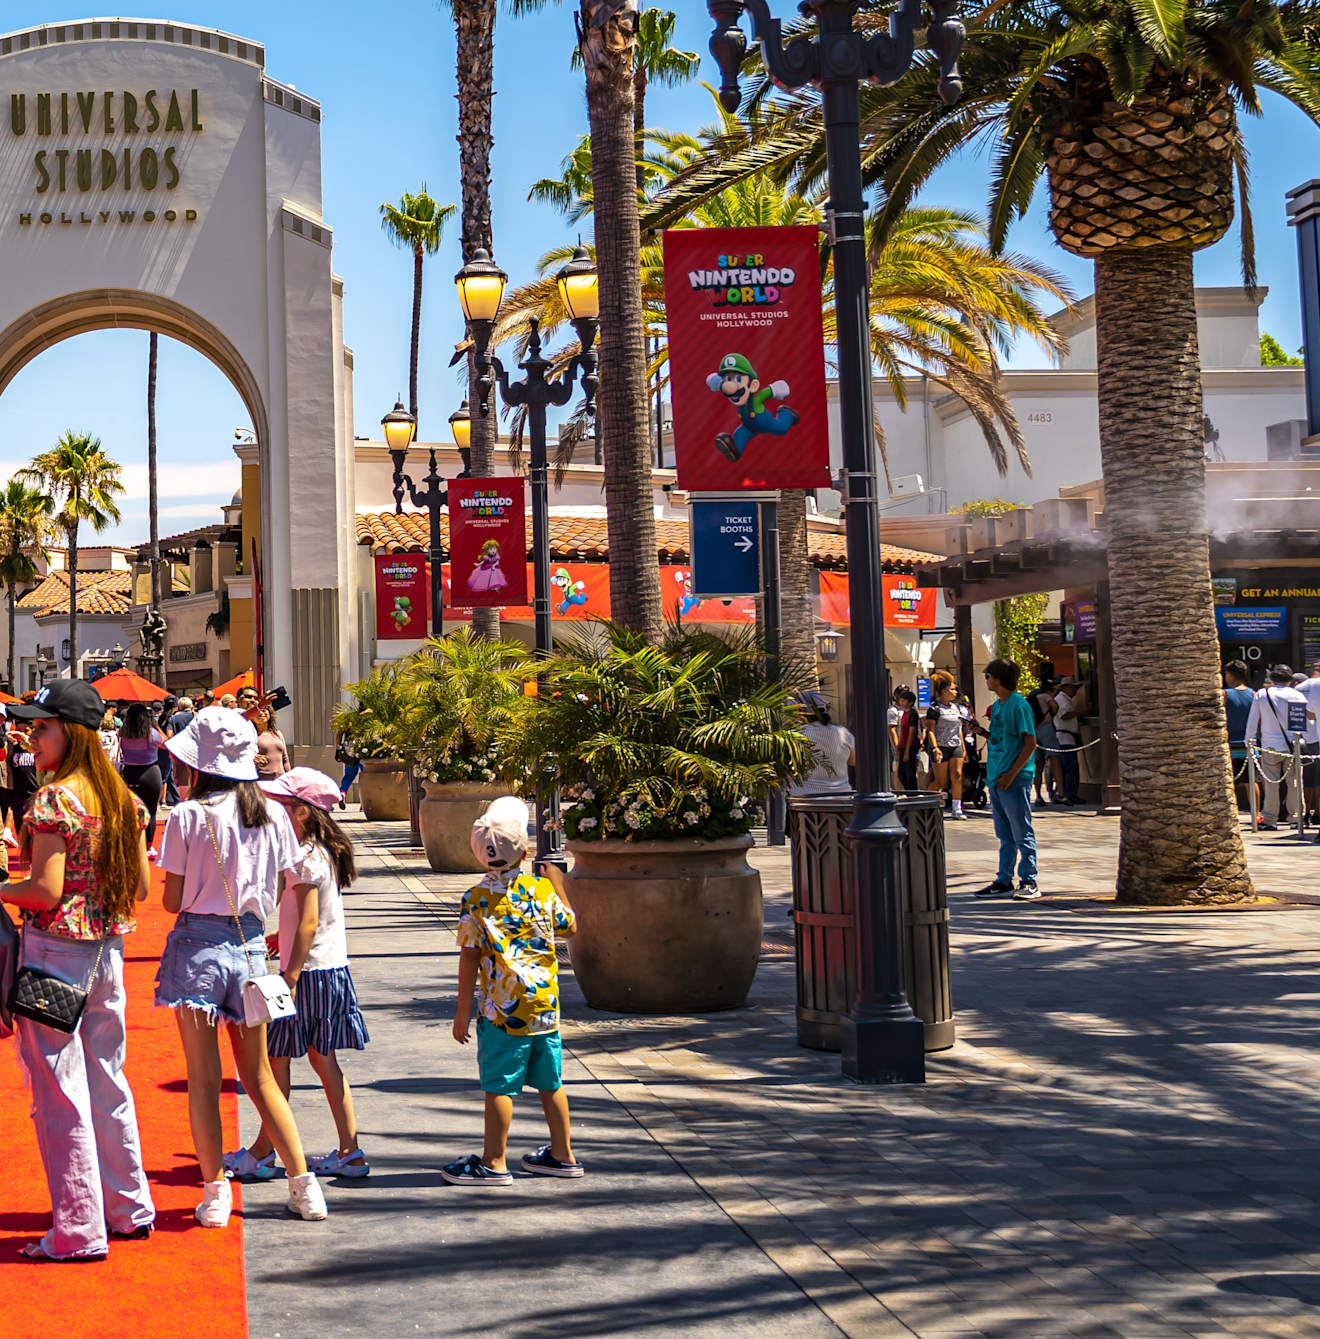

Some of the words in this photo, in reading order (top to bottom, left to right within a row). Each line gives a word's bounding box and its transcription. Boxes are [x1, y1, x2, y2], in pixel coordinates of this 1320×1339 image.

[11, 89, 203, 136] UNIVERSAL
[34, 147, 180, 194] STUDIOS
[19, 209, 198, 225] HOLLYWOOD
[717, 254, 765, 268] SUPER
[688, 267, 796, 288] NINTENDO
[704, 286, 779, 304] WORLD
[1027, 413, 1052, 423] 4483
[459, 497, 513, 508] NINTENDO
[725, 516, 752, 524] TICKET
[720, 525, 753, 533] BOOTHS
[382, 566, 418, 574] NINTENDO
[1241, 588, 1262, 597] GET
[1263, 588, 1279, 597] AN
[1239, 646, 1262, 660] 10
